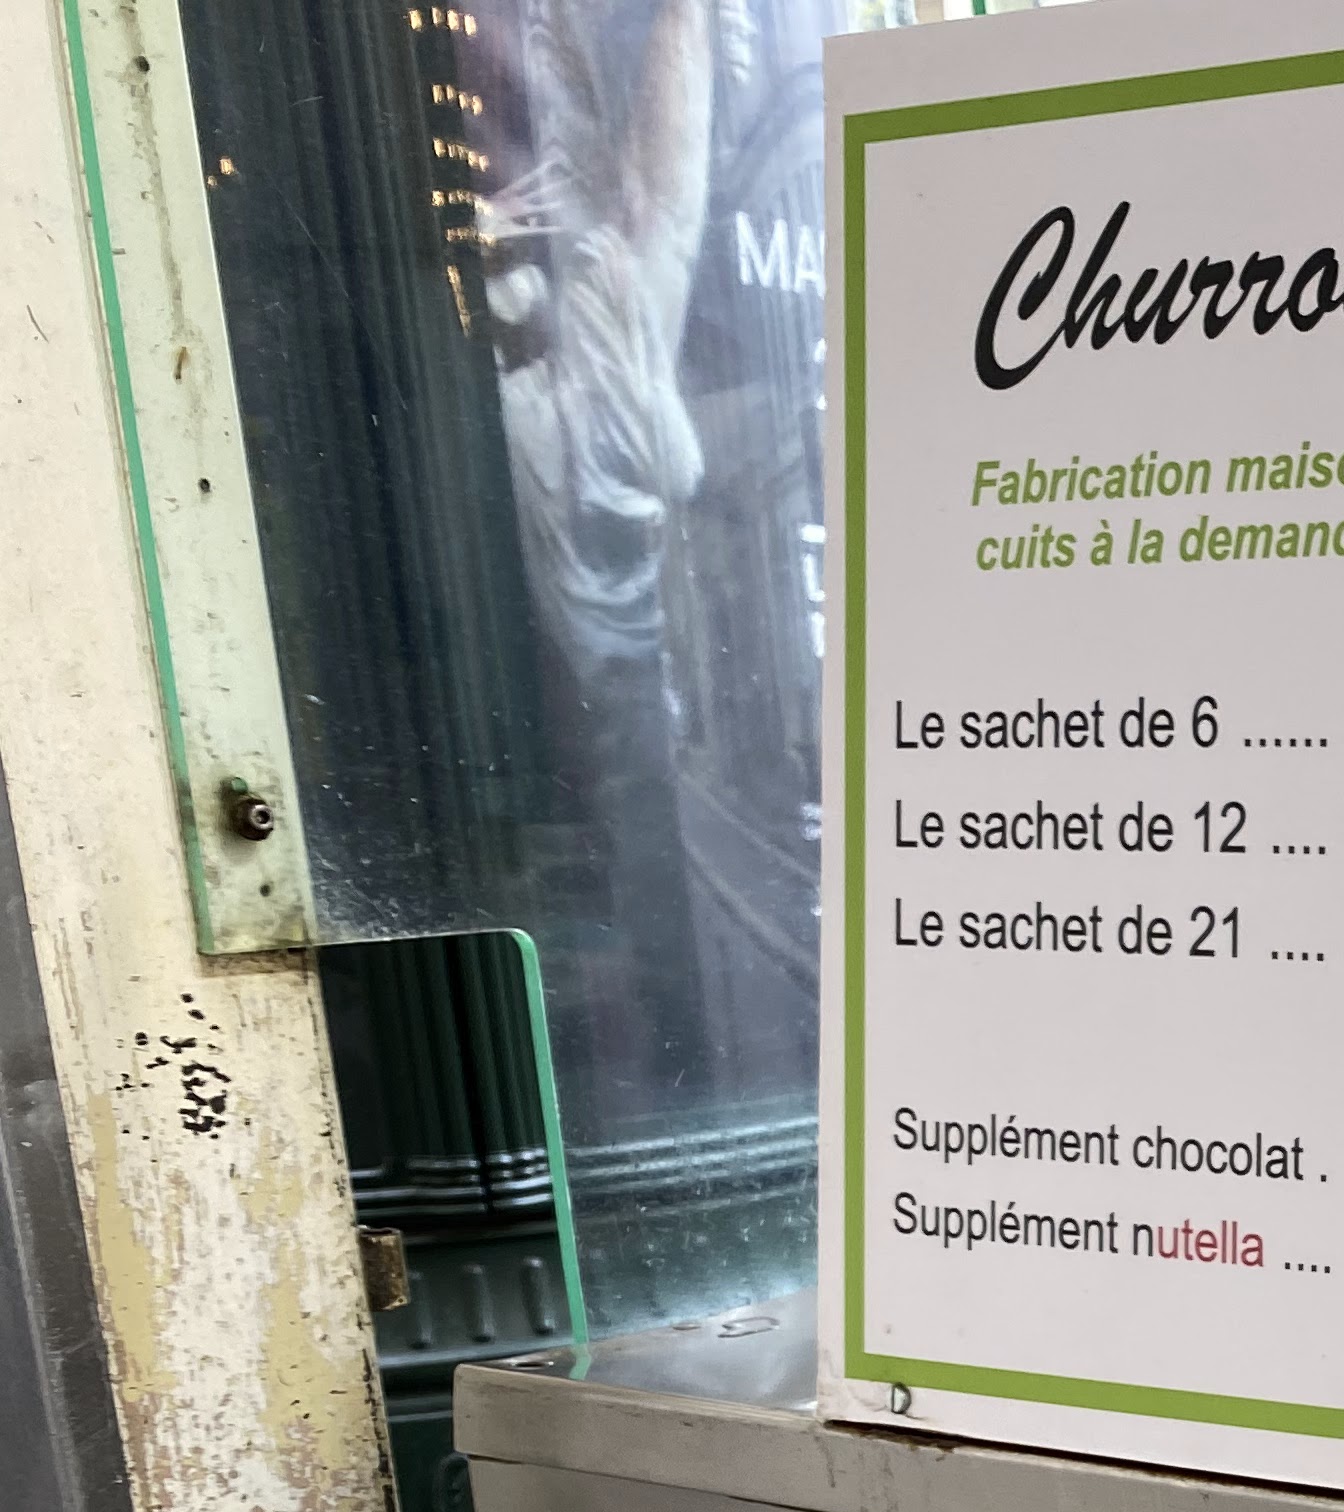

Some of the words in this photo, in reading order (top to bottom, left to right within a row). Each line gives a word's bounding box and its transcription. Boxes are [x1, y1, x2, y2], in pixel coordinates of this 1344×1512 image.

[971, 450, 1211, 506] Fabrication
[976, 523, 1077, 571] cuits
[1090, 518, 1113, 566] à
[1127, 518, 1164, 564] la
[895, 700, 945, 749] Le
[959, 698, 1105, 749] sachet
[1119, 696, 1176, 748] de
[1191, 695, 1219, 749] 6
[895, 799, 945, 849] Le
[959, 800, 1104, 851] sachet
[1118, 800, 1175, 852] de
[1193, 801, 1248, 855] 12
[895, 897, 944, 947] Le
[959, 901, 1103, 953] sachet
[1117, 904, 1173, 956] de
[1189, 905, 1241, 959] 21
[893, 1107, 1120, 1166] Supplément
[1131, 1125, 1304, 1181] chocolat
[893, 1192, 1119, 1256] Supplément
[1131, 1217, 1265, 1268] nutella
